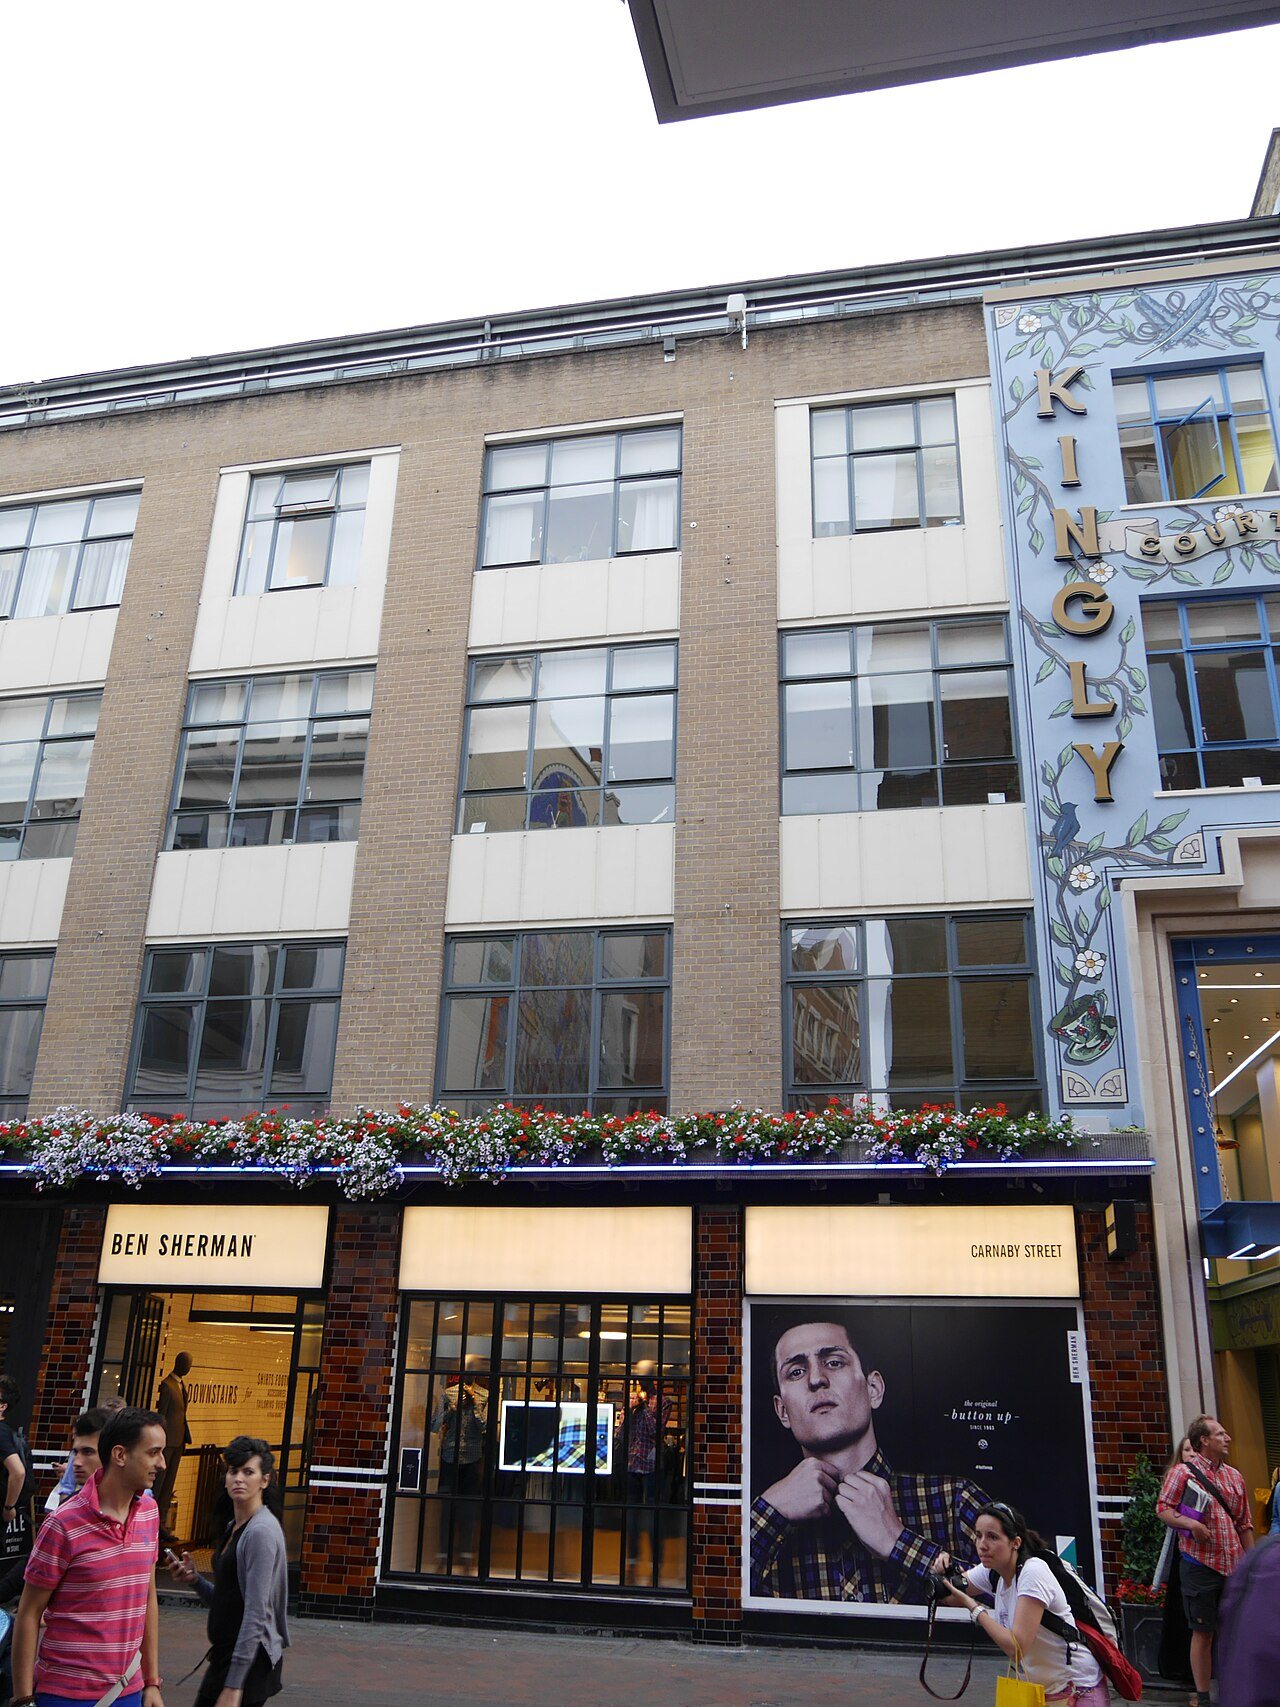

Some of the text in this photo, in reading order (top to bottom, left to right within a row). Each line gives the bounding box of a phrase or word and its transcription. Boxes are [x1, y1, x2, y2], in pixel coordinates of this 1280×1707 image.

[1033, 366, 1125, 803] KINGLY
[111, 1233, 253, 1257] BEN SHERMAN
[971, 1244, 1062, 1258] CARNABY STREET
[187, 1383, 239, 1404] DOWNSTAIRS
[974, 1400, 998, 1409] original
[951, 1409, 1012, 1425] button up
